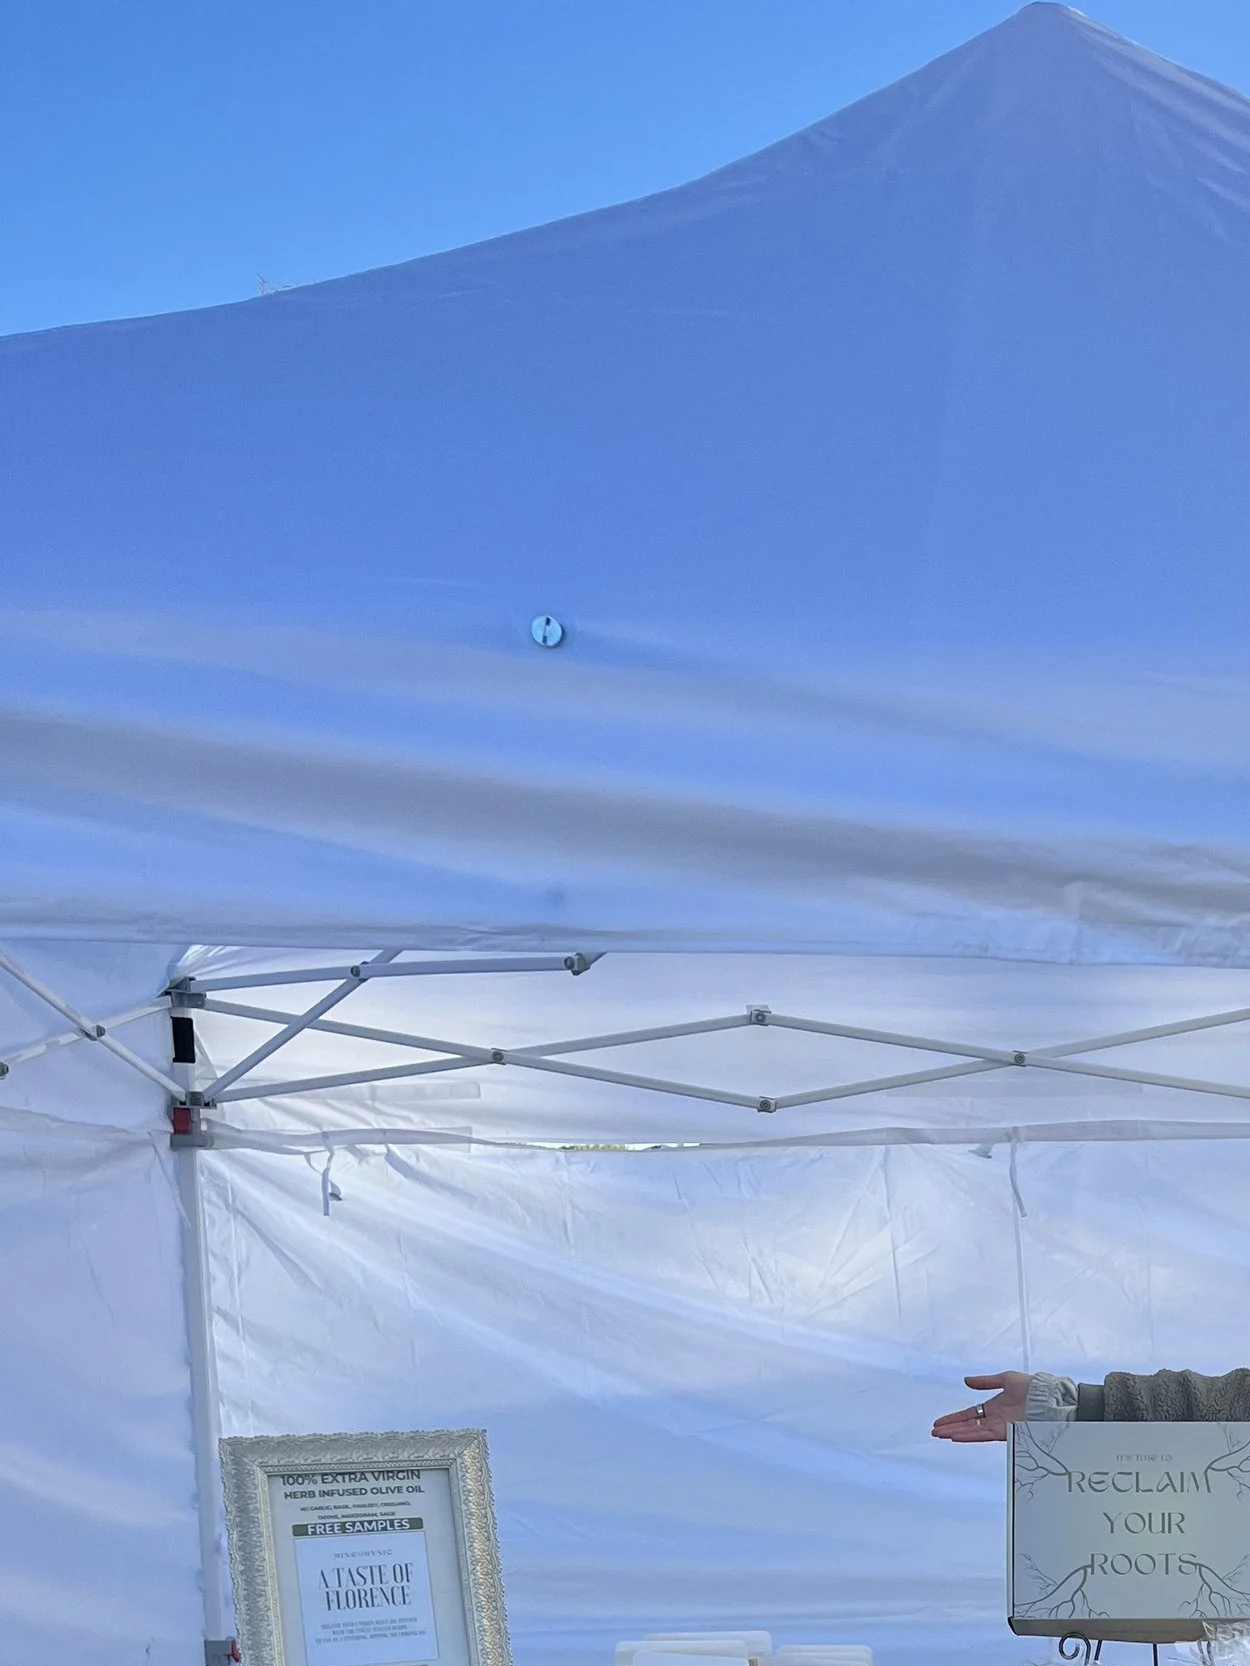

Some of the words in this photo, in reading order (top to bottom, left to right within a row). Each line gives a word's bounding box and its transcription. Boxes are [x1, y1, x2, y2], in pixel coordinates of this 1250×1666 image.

[280, 1474, 318, 1486] 100%
[321, 1471, 369, 1485] EXTRA
[370, 1468, 422, 1482] VIRGIN
[1067, 1471, 1212, 1493] RECLAIM
[284, 1490, 317, 1500] HERB
[318, 1487, 368, 1498] INFUSED
[370, 1486, 404, 1495] OLIVE
[406, 1485, 426, 1494] OIL
[307, 1523, 343, 1536] FREE
[345, 1519, 410, 1533] SAMPLES
[1102, 1512, 1186, 1534] YOUR
[1090, 1552, 1198, 1576] ROOTS
[318, 1568, 329, 1590] A
[331, 1564, 389, 1589] TASTE
[391, 1562, 414, 1584] OF
[325, 1585, 413, 1612] FLORENCE
